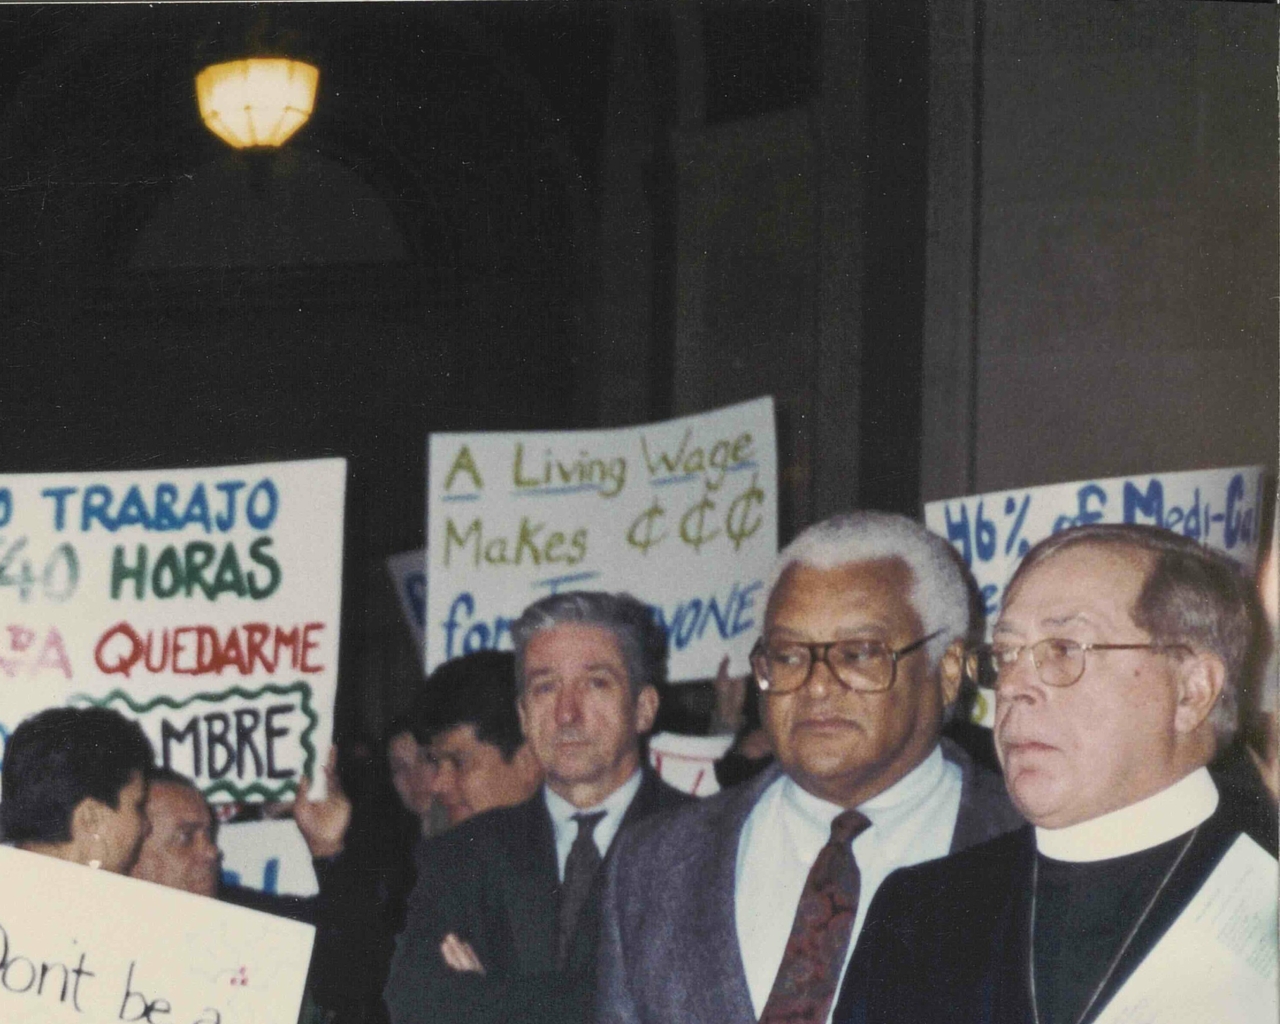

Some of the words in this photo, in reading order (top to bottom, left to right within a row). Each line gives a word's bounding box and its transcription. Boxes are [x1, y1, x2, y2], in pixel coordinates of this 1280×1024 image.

[444, 445, 483, 490] A
[512, 443, 627, 498] Living
[640, 428, 753, 490] Wage
[42, 478, 279, 533] TRABAJO
[111, 536, 282, 601] HORAS
[444, 516, 588, 568] Makes
[94, 621, 326, 678] QUEDARME
[160, 705, 297, 779] MBRE
